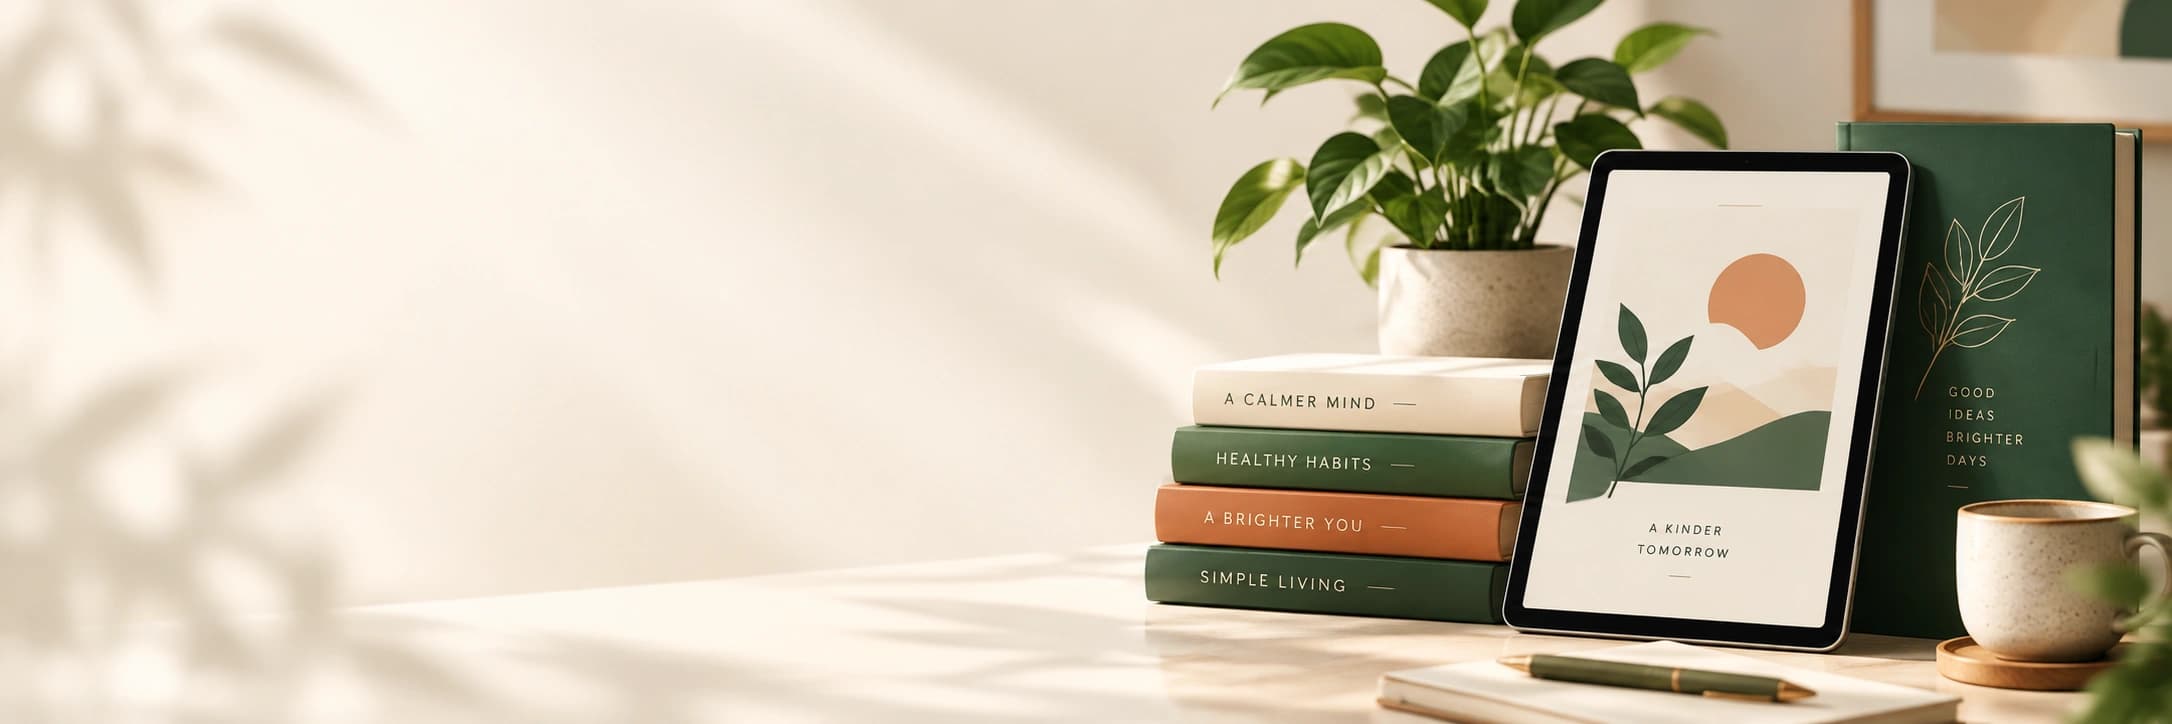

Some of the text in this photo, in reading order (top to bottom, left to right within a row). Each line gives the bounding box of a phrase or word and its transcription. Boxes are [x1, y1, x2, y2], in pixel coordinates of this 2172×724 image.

[1949, 386, 1995, 398] GOOD
[1224, 392, 1376, 410] A CALMER MIND
[1949, 409, 1995, 421] IDEAS
[1946, 431, 2024, 445] BRIGHTER
[1216, 451, 1372, 472] HEALTHY HABITS
[1947, 454, 1987, 467] DAYS
[1204, 511, 1363, 533] A BRIGHTER YOU
[1649, 523, 1722, 536] A KINDER
[1637, 544, 1729, 558] TOMORROW
[1200, 570, 1346, 593] SIMPLE LIVING
